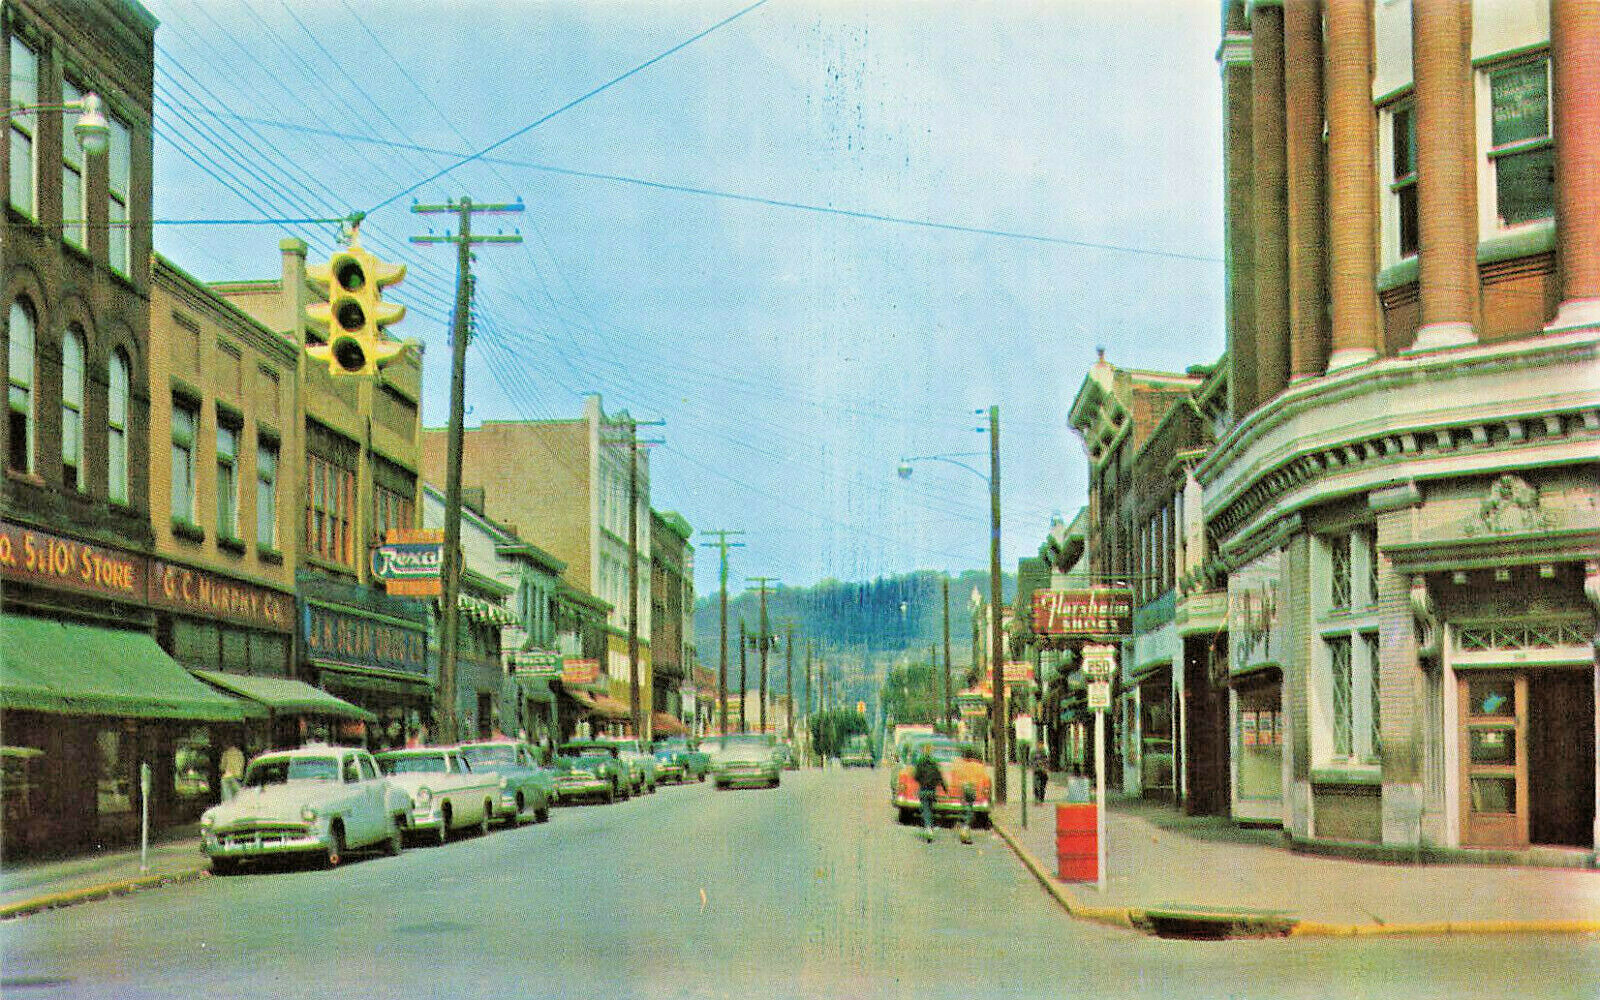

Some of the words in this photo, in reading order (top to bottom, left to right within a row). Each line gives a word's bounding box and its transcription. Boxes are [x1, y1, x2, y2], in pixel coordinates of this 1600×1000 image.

[80, 545, 134, 592] STORE
[377, 547, 444, 576] Rexal
[1038, 590, 1130, 628] Florsheim
[1062, 616, 1118, 629] SHOES
